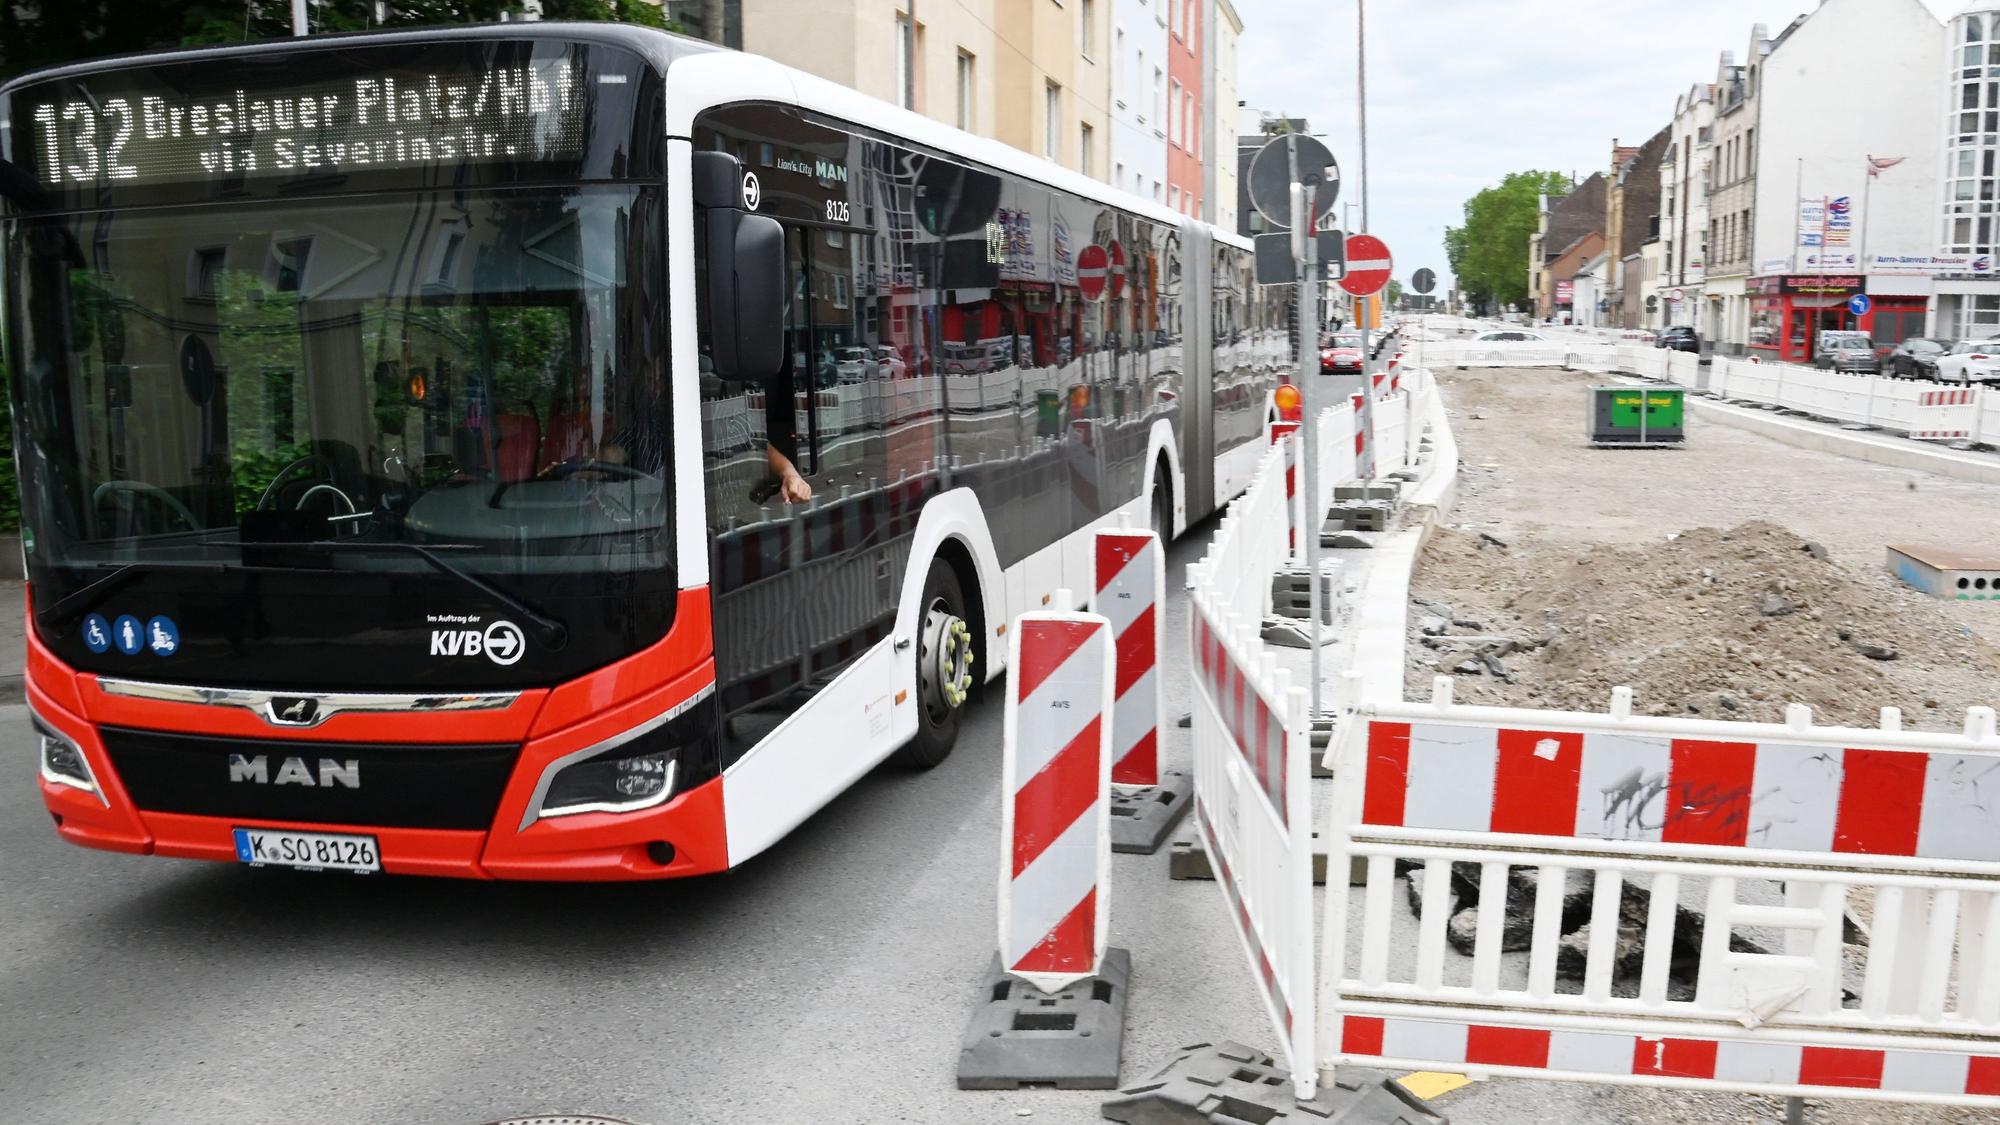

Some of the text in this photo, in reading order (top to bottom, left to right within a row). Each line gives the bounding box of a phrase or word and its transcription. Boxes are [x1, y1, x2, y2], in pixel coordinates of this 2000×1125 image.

[34, 65, 572, 183] 132 Breslauer Platz/Hbf
[200, 126, 515, 173] via Severinstr.
[777, 157, 848, 182] Lion's City MAN
[826, 199, 850, 222] 8126
[986, 222, 1005, 264] 132
[438, 614, 467, 625] Auftrag
[468, 614, 481, 623] der
[430, 630, 483, 656] KVB
[1050, 700, 1071, 709] AVS
[229, 753, 361, 789] MAN
[251, 835, 375, 865] K SO 8126
